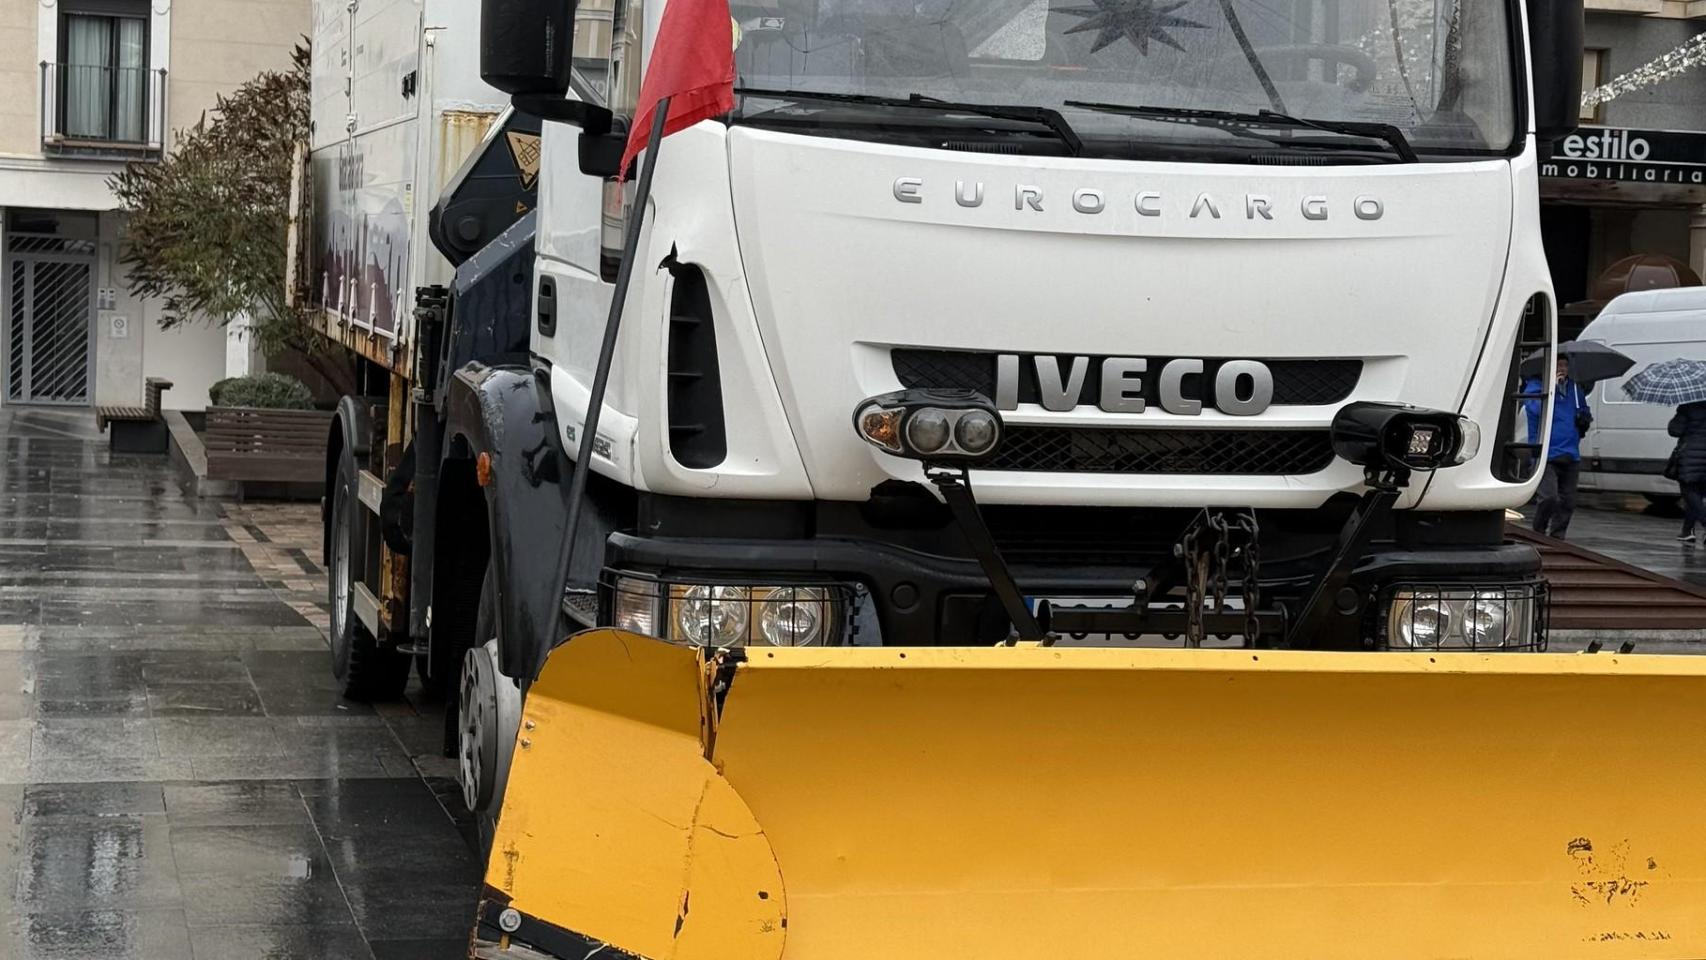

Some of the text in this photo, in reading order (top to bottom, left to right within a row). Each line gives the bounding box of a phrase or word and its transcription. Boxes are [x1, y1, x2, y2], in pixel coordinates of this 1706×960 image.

[1563, 129, 1650, 160] estilo
[893, 176, 1385, 221] EUROCARGO
[997, 354, 1274, 416] IVECO
